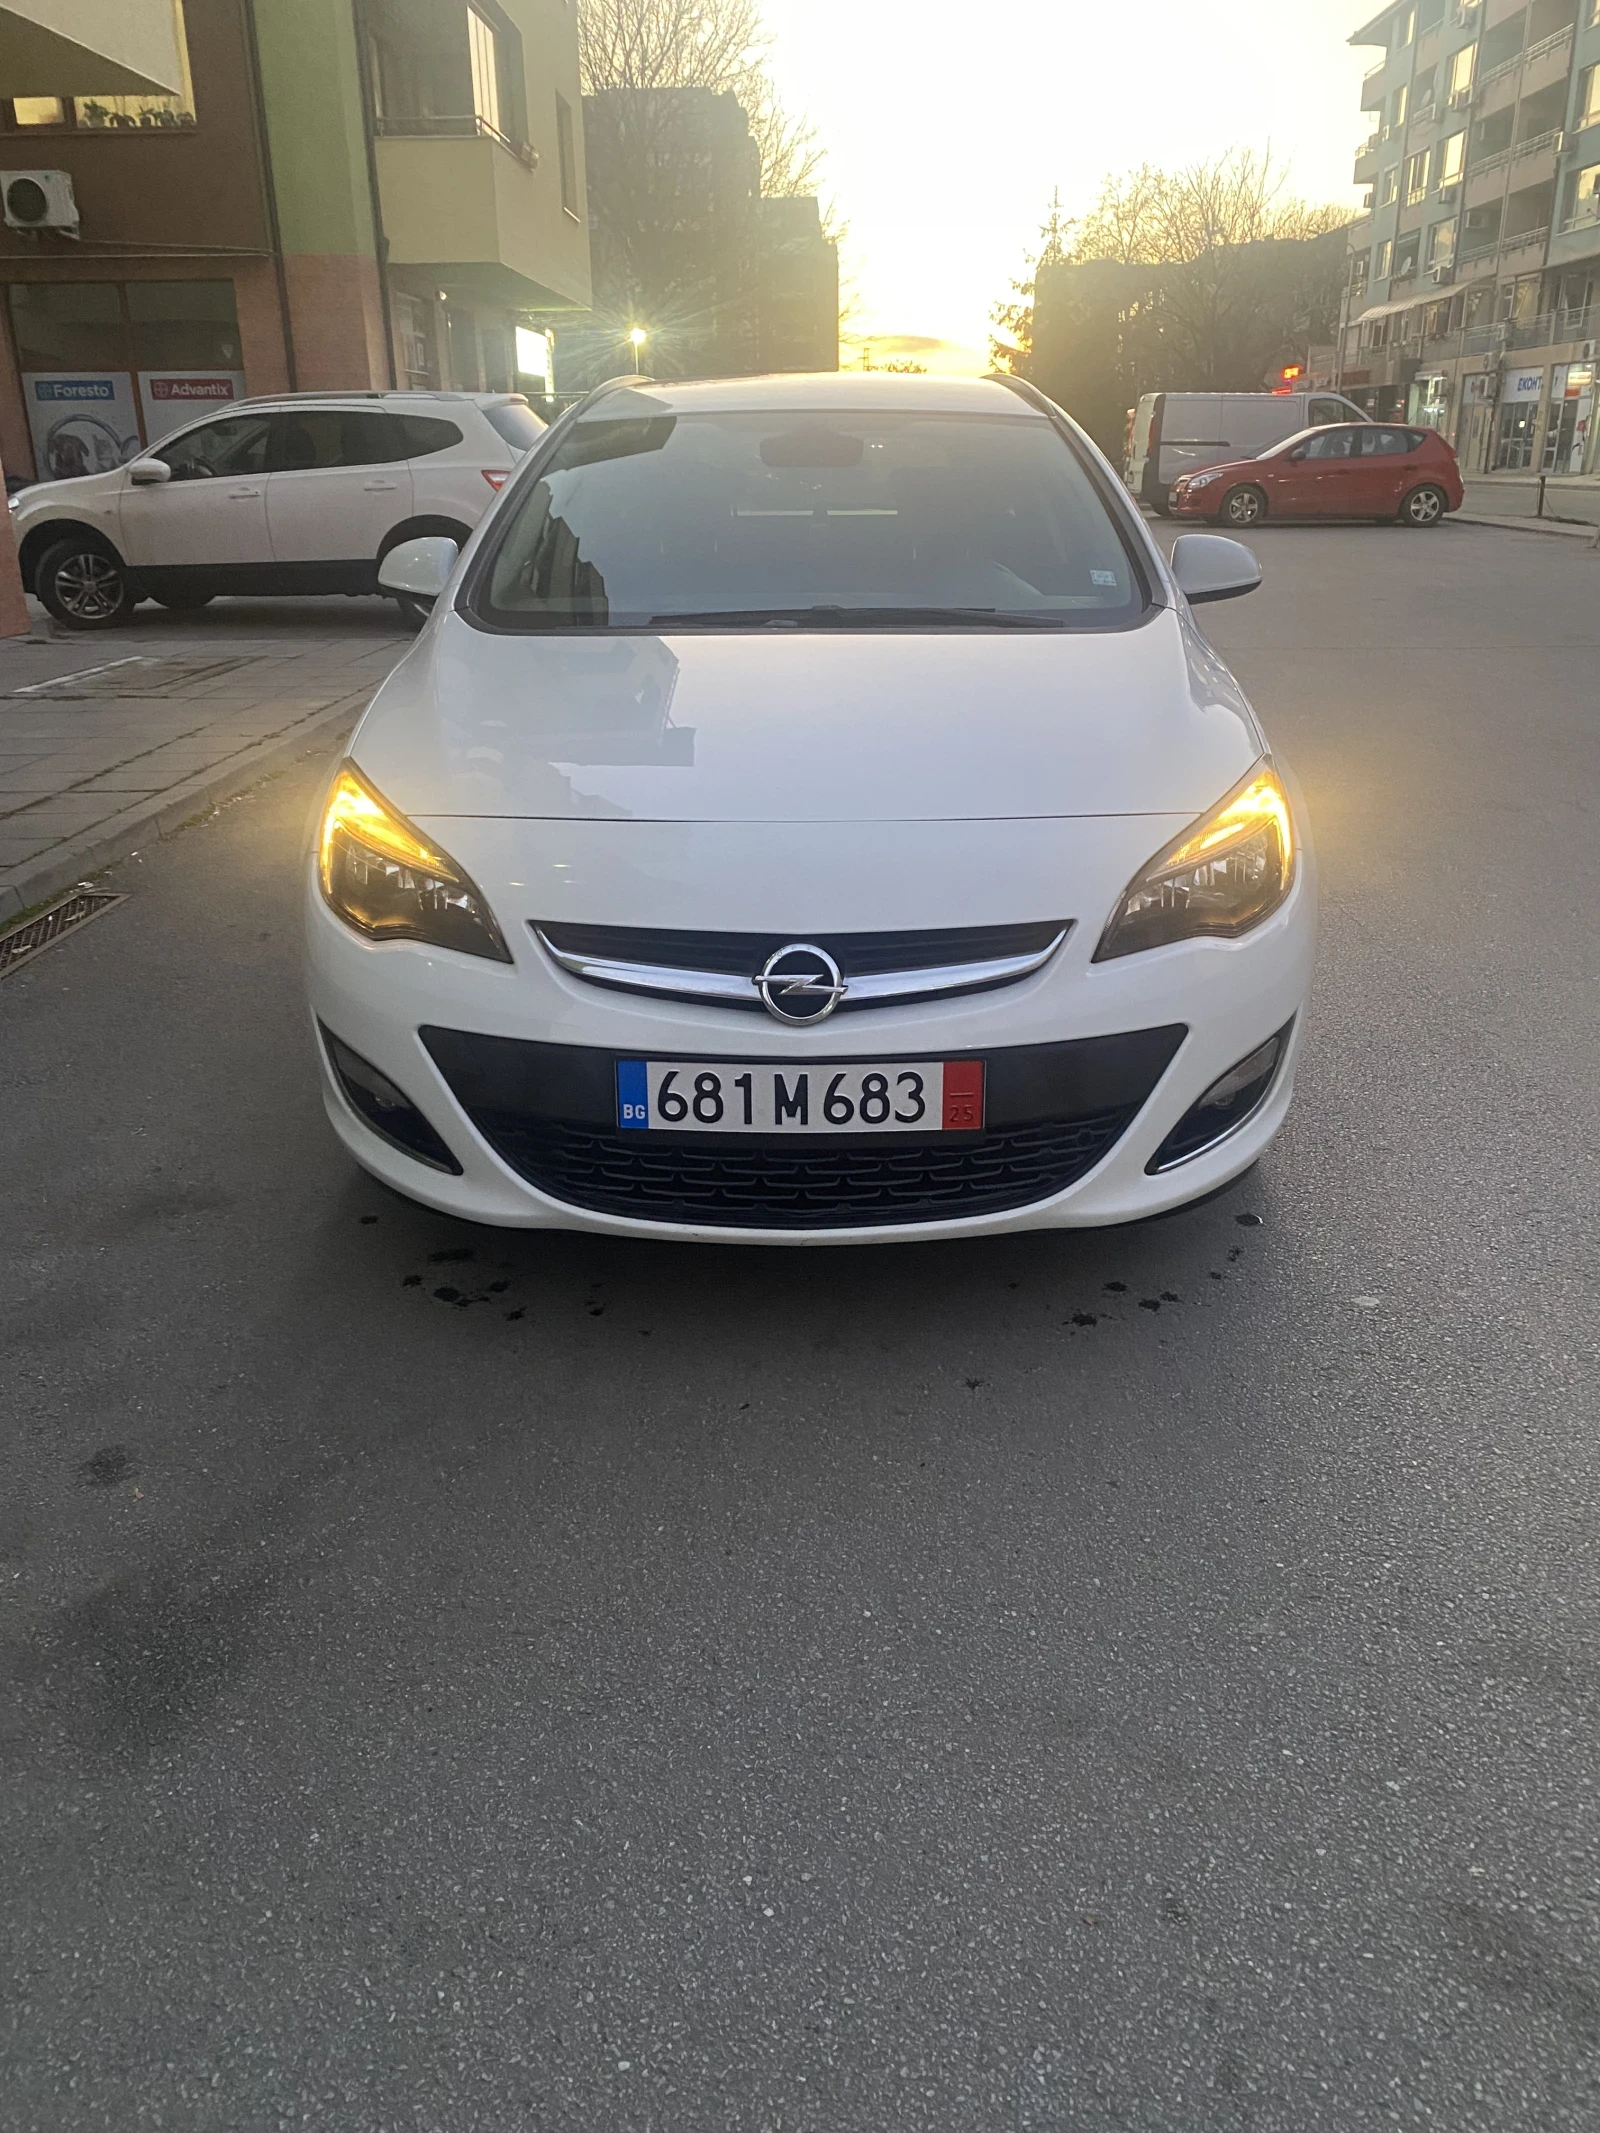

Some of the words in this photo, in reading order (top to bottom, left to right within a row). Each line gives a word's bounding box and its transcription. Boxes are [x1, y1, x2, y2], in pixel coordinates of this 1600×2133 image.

[53, 384, 109, 397] Foresto
[171, 384, 228, 396] Advantix
[623, 1103, 646, 1119] BG
[950, 1105, 974, 1122] 25
